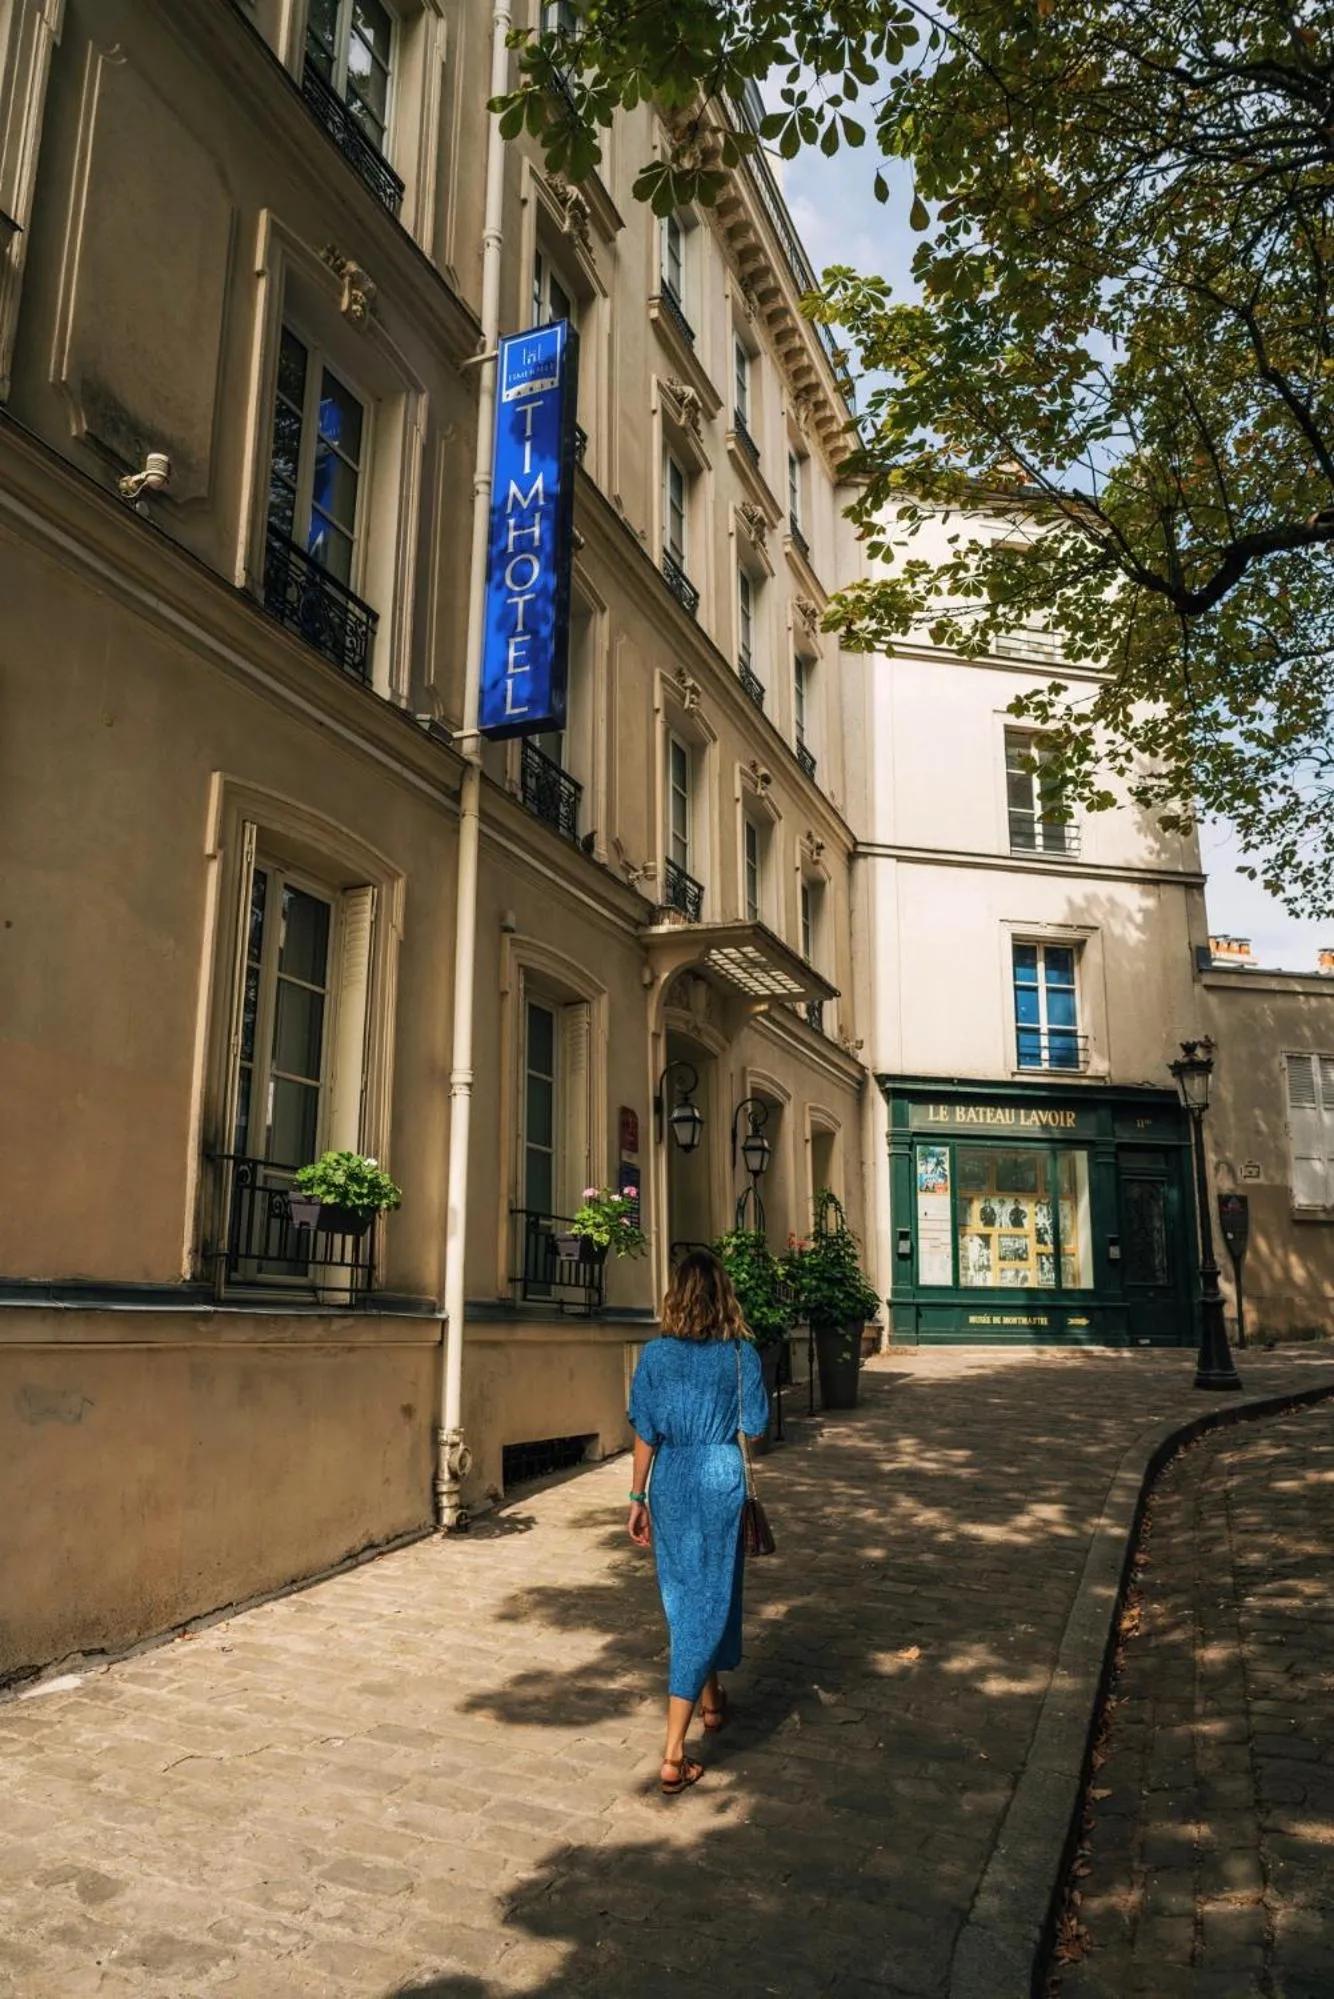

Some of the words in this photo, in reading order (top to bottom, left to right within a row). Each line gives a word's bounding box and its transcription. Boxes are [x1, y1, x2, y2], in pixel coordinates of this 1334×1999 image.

[504, 400, 546, 716] TIMHOTEL
[928, 1105, 949, 1122] LE
[955, 1105, 1015, 1125] BATEAU
[1020, 1109, 1076, 1129] LAVOIR
